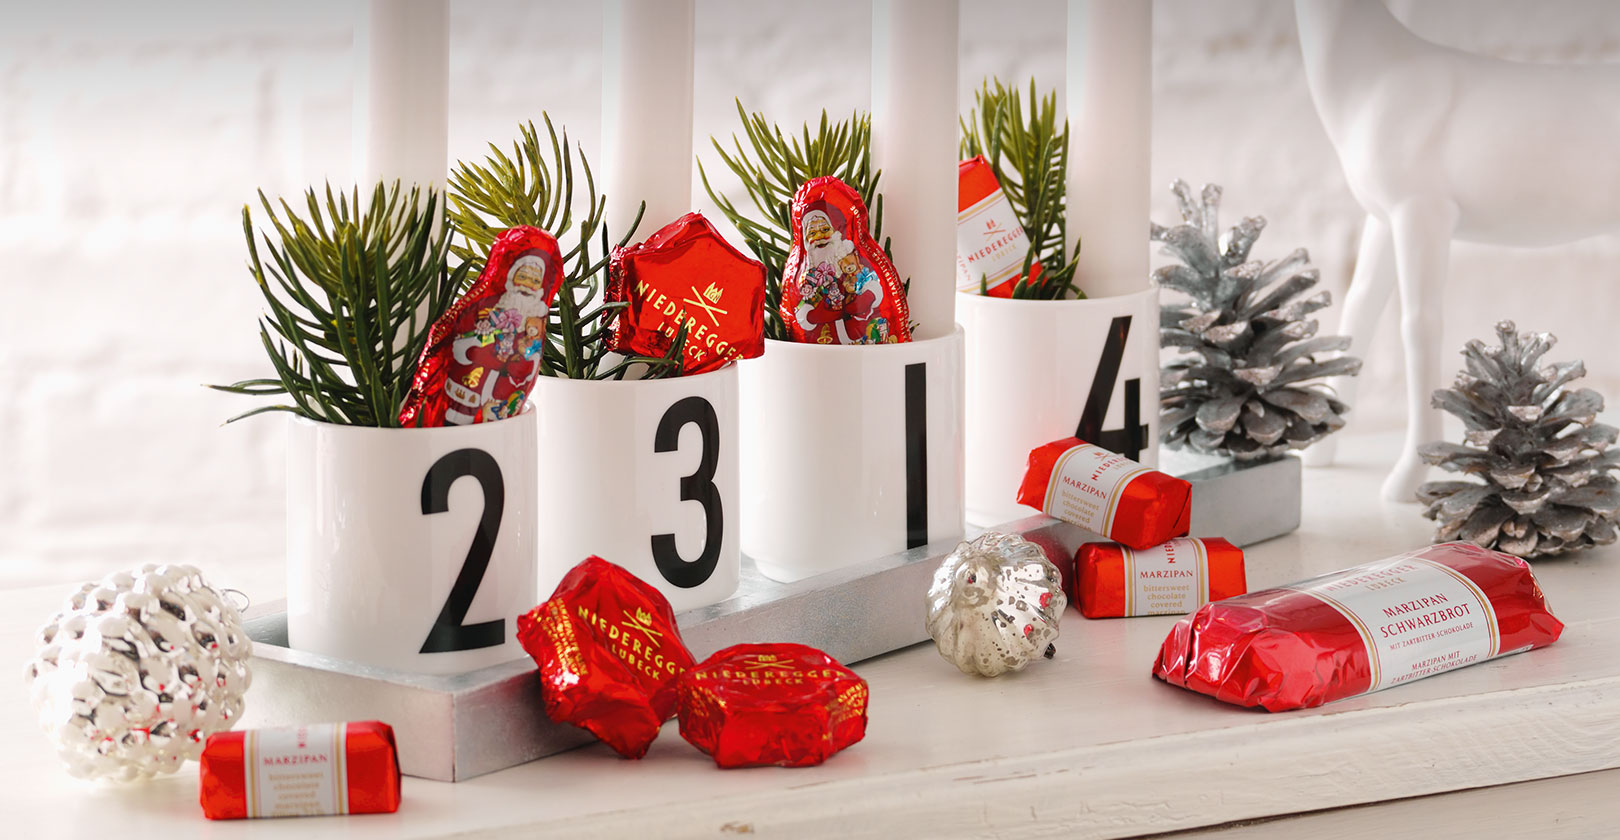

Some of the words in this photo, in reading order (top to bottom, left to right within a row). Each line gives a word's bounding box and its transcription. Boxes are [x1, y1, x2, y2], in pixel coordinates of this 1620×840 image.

[1075, 315, 1149, 462] 4
[905, 362, 928, 550] 1
[651, 396, 723, 588] 3
[1063, 476, 1107, 499] MARZIPAN
[1063, 500, 1095, 517] chocolate
[1064, 509, 1091, 524] covered
[418, 447, 505, 654] 2
[1140, 570, 1193, 579] MARZIPAN
[1143, 584, 1190, 592] bittersweet
[1147, 592, 1186, 600] chocolate
[1382, 593, 1448, 618] MARZIPAN
[1380, 603, 1471, 638] SCHWARZBROT
[1390, 641, 1401, 650] MIT
[1411, 655, 1446, 671] MARZIPAN
[1448, 651, 1460, 660] MIT
[696, 670, 847, 680] NIEDEREGGER
